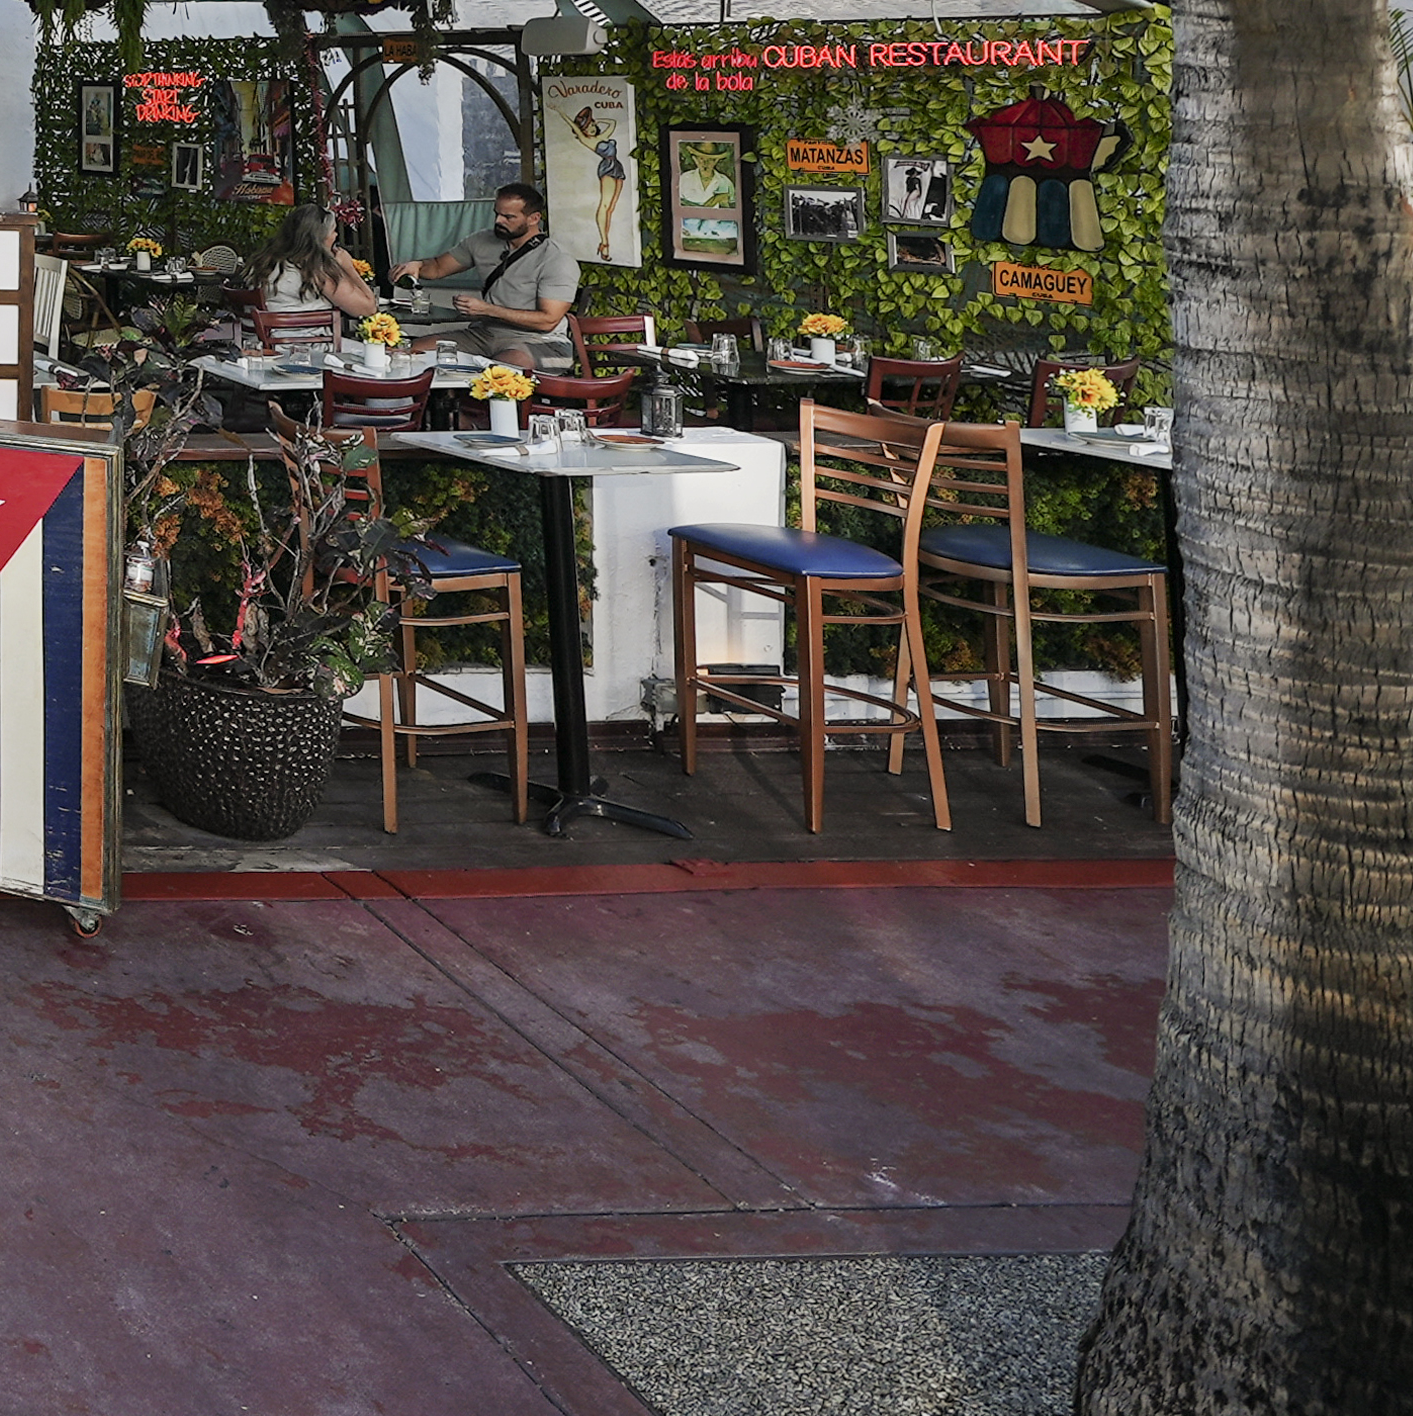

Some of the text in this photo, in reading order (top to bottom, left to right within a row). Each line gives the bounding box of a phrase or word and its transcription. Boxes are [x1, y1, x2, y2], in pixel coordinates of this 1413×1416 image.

[763, 39, 1091, 68] CUBAN RESTAURANT
[122, 71, 206, 88] STOP THINKING
[666, 71, 753, 91] de la bola
[142, 88, 179, 106] START
[548, 80, 623, 99] Varadero
[136, 104, 201, 124] DRINKING
[594, 101, 624, 109] CUBA
[790, 147, 864, 165] MATANZAS
[999, 269, 1088, 295] CAMAGUEY
